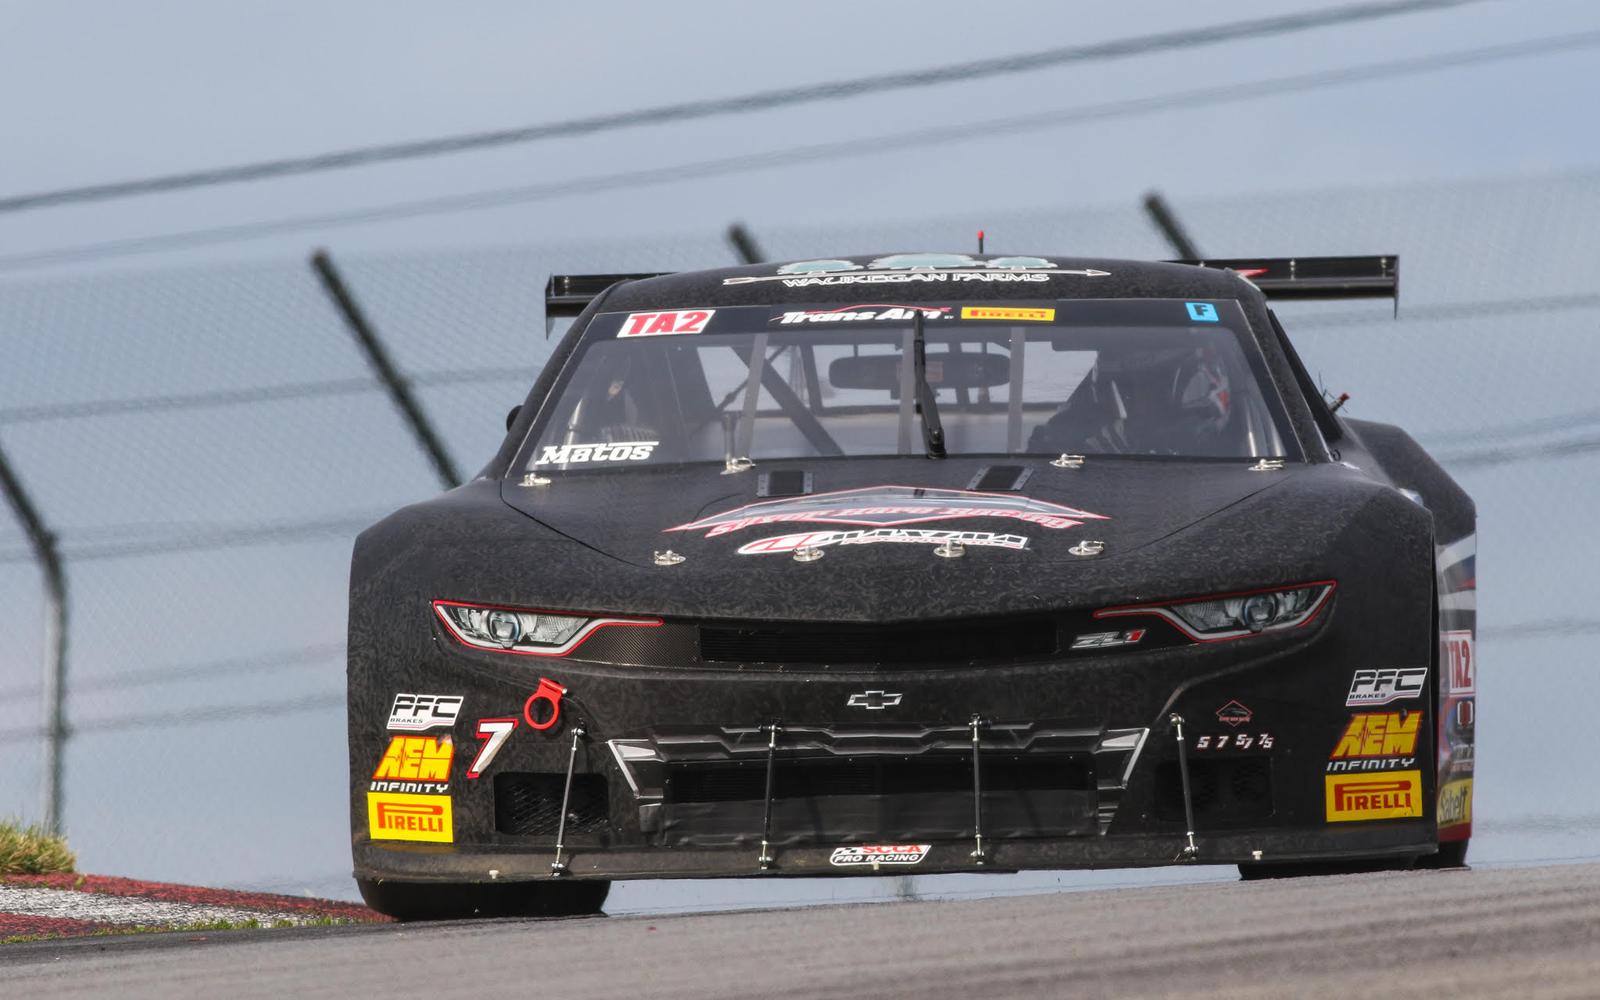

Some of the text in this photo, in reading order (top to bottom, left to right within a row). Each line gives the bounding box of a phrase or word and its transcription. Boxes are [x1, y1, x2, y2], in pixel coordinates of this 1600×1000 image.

[782, 272, 1050, 288] WAUKEGAN FARMS
[780, 311, 878, 324] Trans
[1194, 303, 1209, 316] F
[626, 310, 710, 336] TA2
[535, 441, 660, 466] Matos
[1072, 629, 1147, 649] ZL1
[1352, 669, 1426, 693] PFC
[392, 695, 462, 718] PFC
[1332, 711, 1423, 758] AEM
[372, 735, 455, 781] AEM
[466, 718, 520, 779] 7
[1326, 757, 1416, 772] INFINITY
[369, 781, 449, 793] INFINITY
[1334, 780, 1412, 812] PIRELLI
[376, 802, 444, 833] PIRELLI
[834, 854, 919, 863] PRO RACING
[862, 844, 922, 854] SCCA
